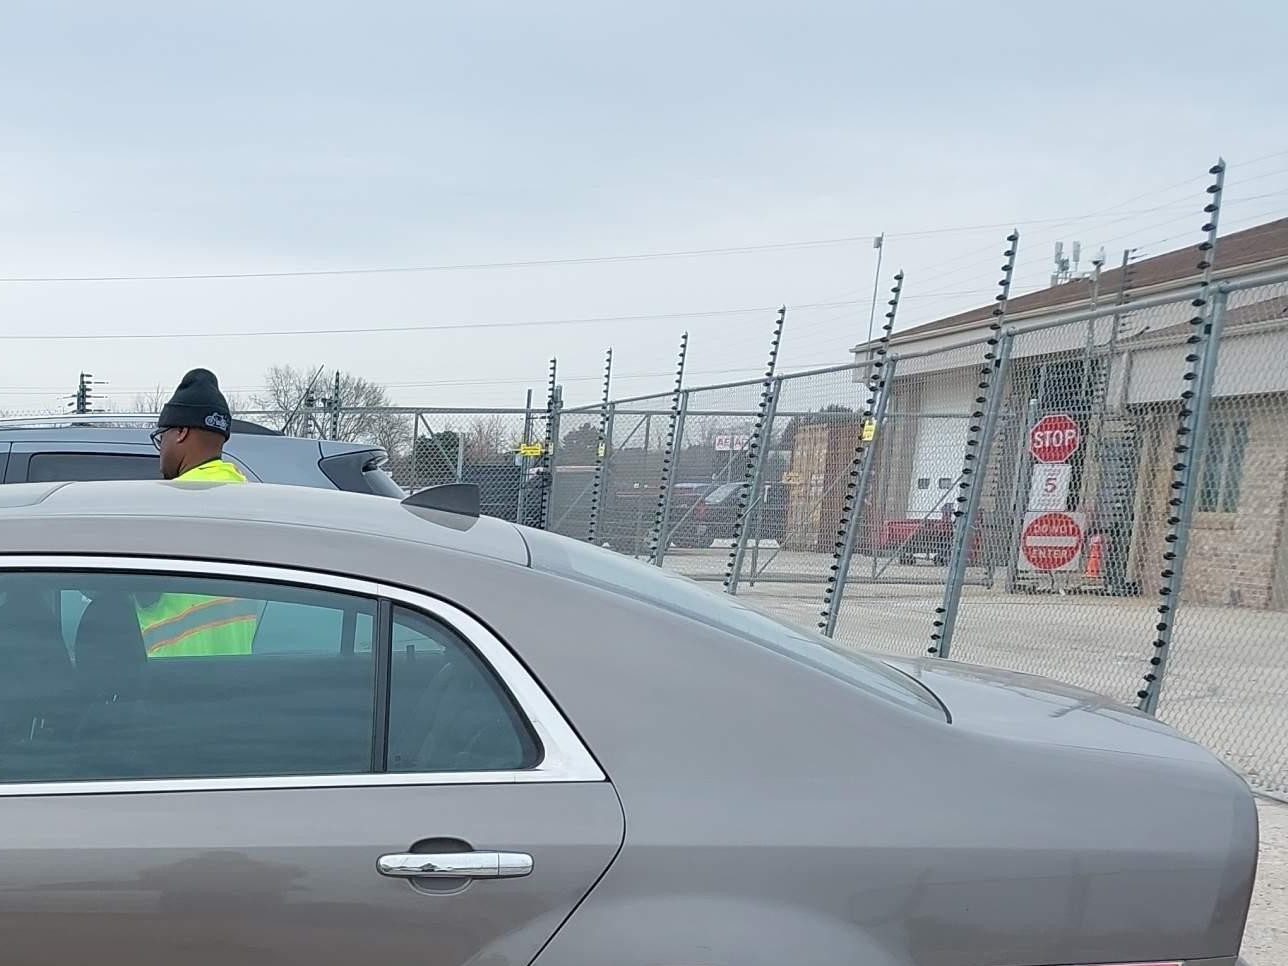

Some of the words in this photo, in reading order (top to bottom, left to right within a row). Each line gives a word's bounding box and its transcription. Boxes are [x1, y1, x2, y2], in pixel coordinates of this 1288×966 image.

[1034, 430, 1077, 449] STOP
[1044, 477, 1057, 493] 5
[1033, 524, 1053, 534] DO
[1031, 548, 1067, 558] ENTER
